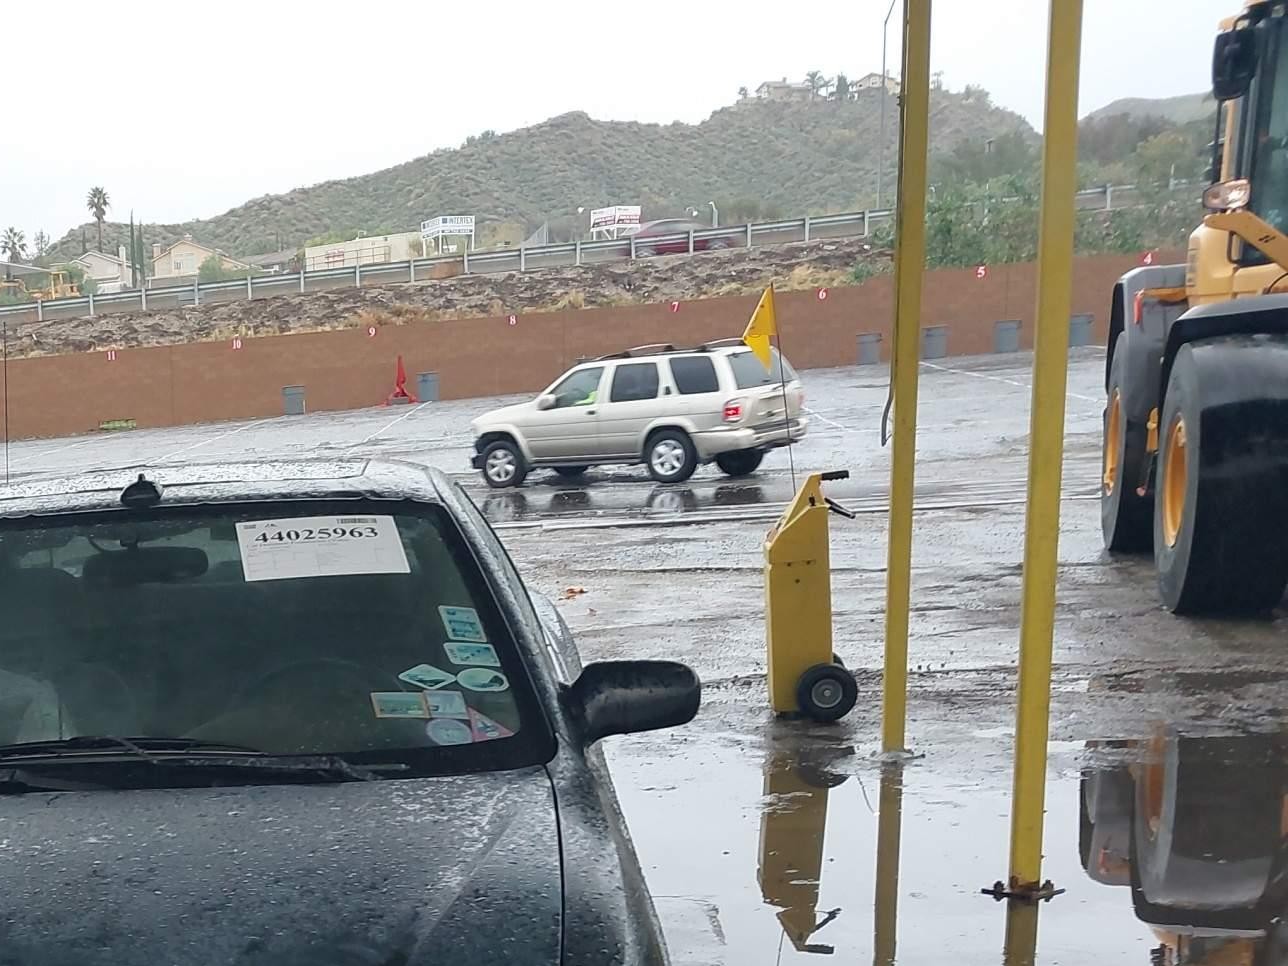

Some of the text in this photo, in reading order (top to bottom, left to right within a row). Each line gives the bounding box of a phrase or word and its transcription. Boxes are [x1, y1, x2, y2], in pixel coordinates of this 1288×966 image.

[1143, 252, 1153, 264] 4
[976, 266, 987, 278] 5
[818, 288, 827, 299] 6
[672, 301, 680, 312] 7
[509, 315, 517, 325] 8
[368, 327, 377, 337] 9
[232, 339, 242, 349] 10
[107, 351, 117, 361] 11
[255, 526, 379, 543] 44025963
